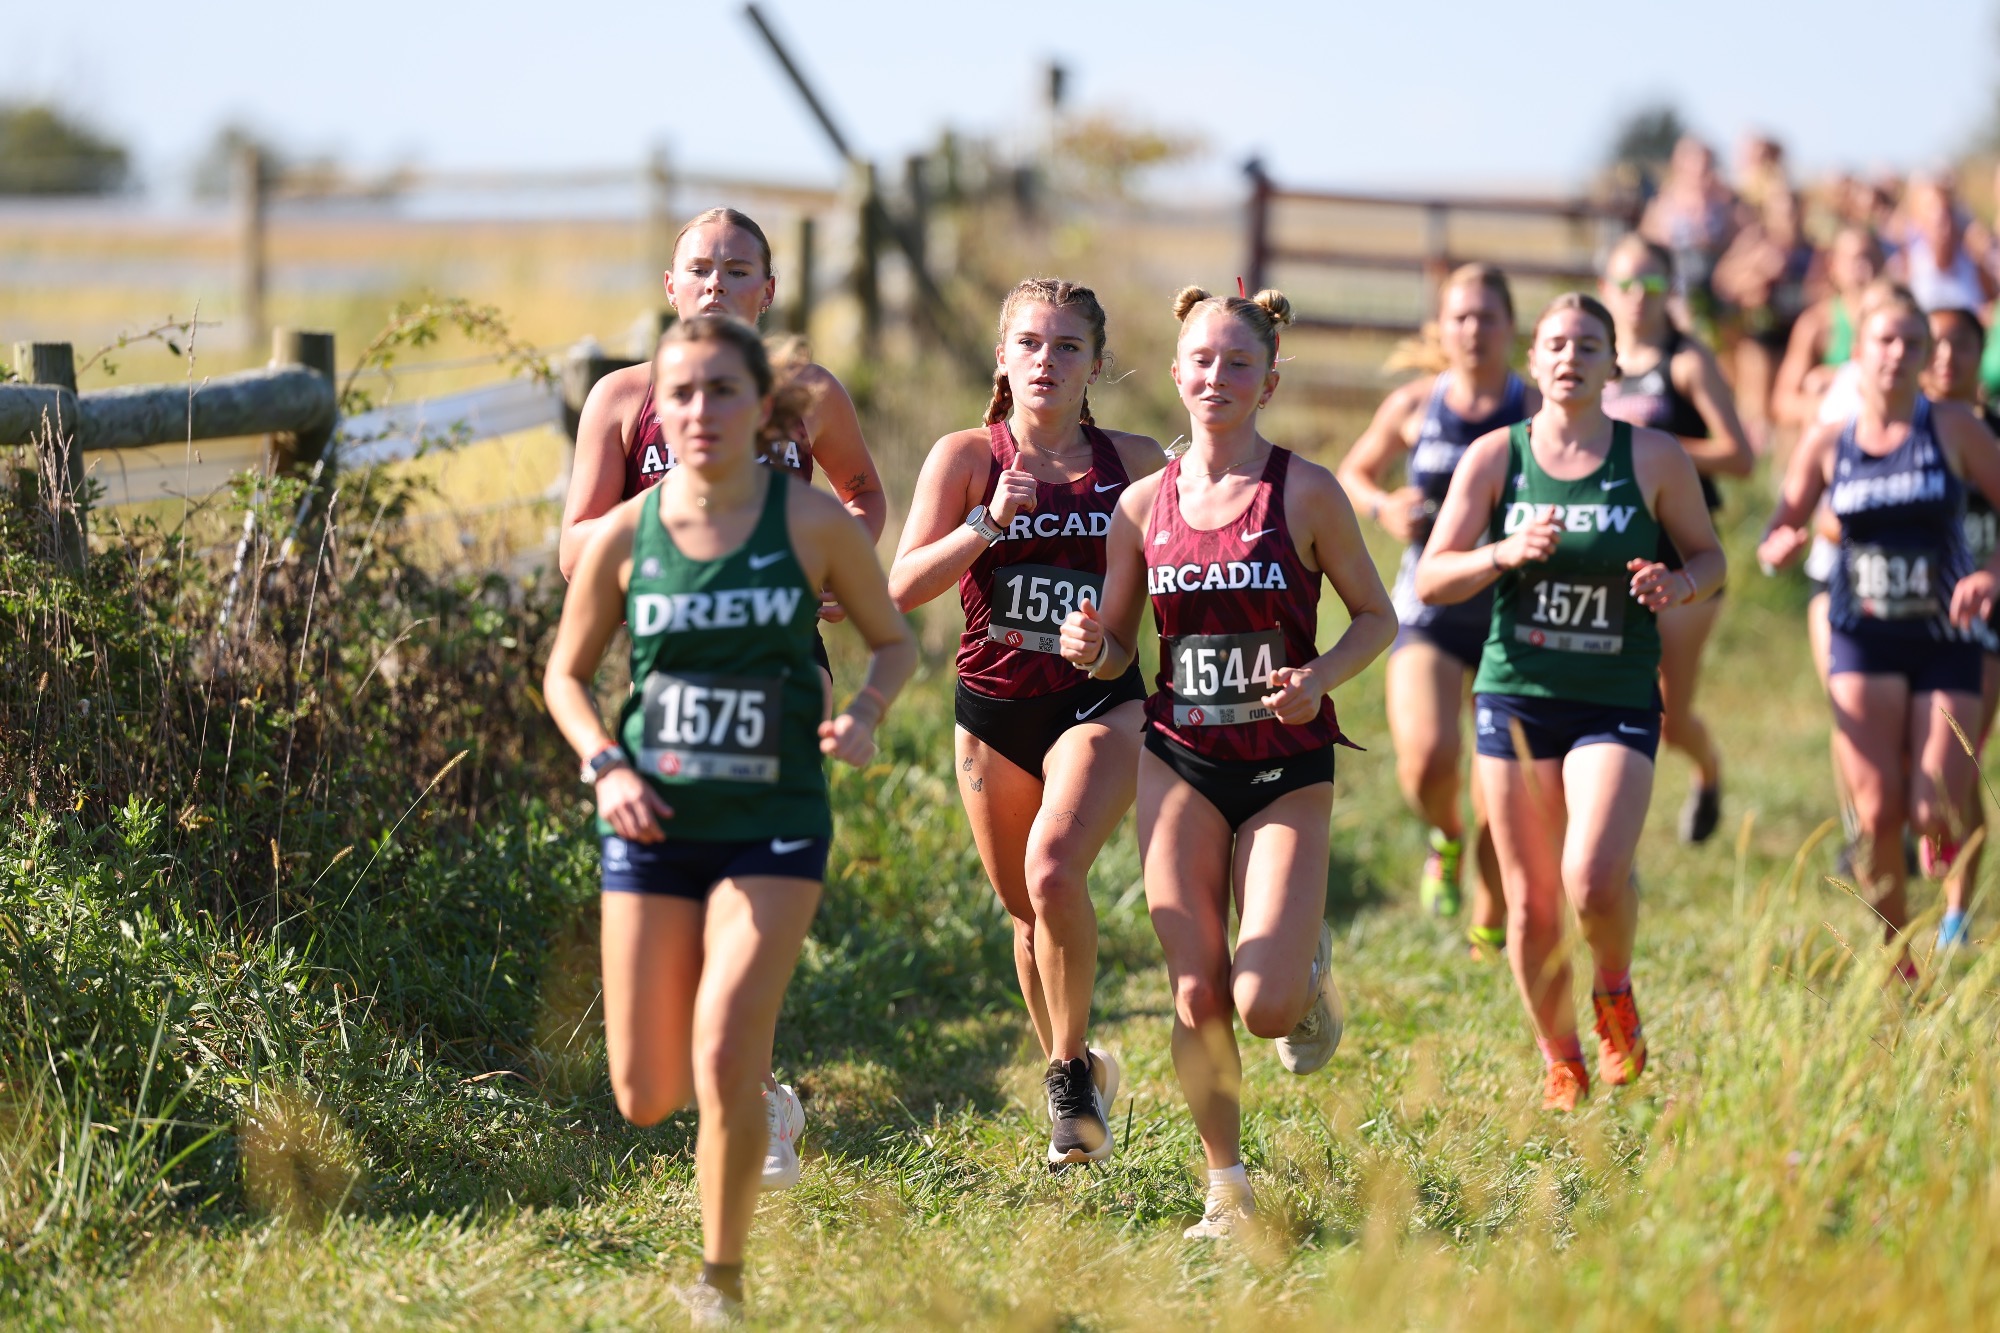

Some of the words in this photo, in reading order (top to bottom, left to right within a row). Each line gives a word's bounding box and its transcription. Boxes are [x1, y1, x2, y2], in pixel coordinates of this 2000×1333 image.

[634, 587, 803, 637] DREW
[1532, 580, 1609, 628] 1571
[1180, 643, 1276, 697] 1544
[657, 684, 766, 748] 1575
